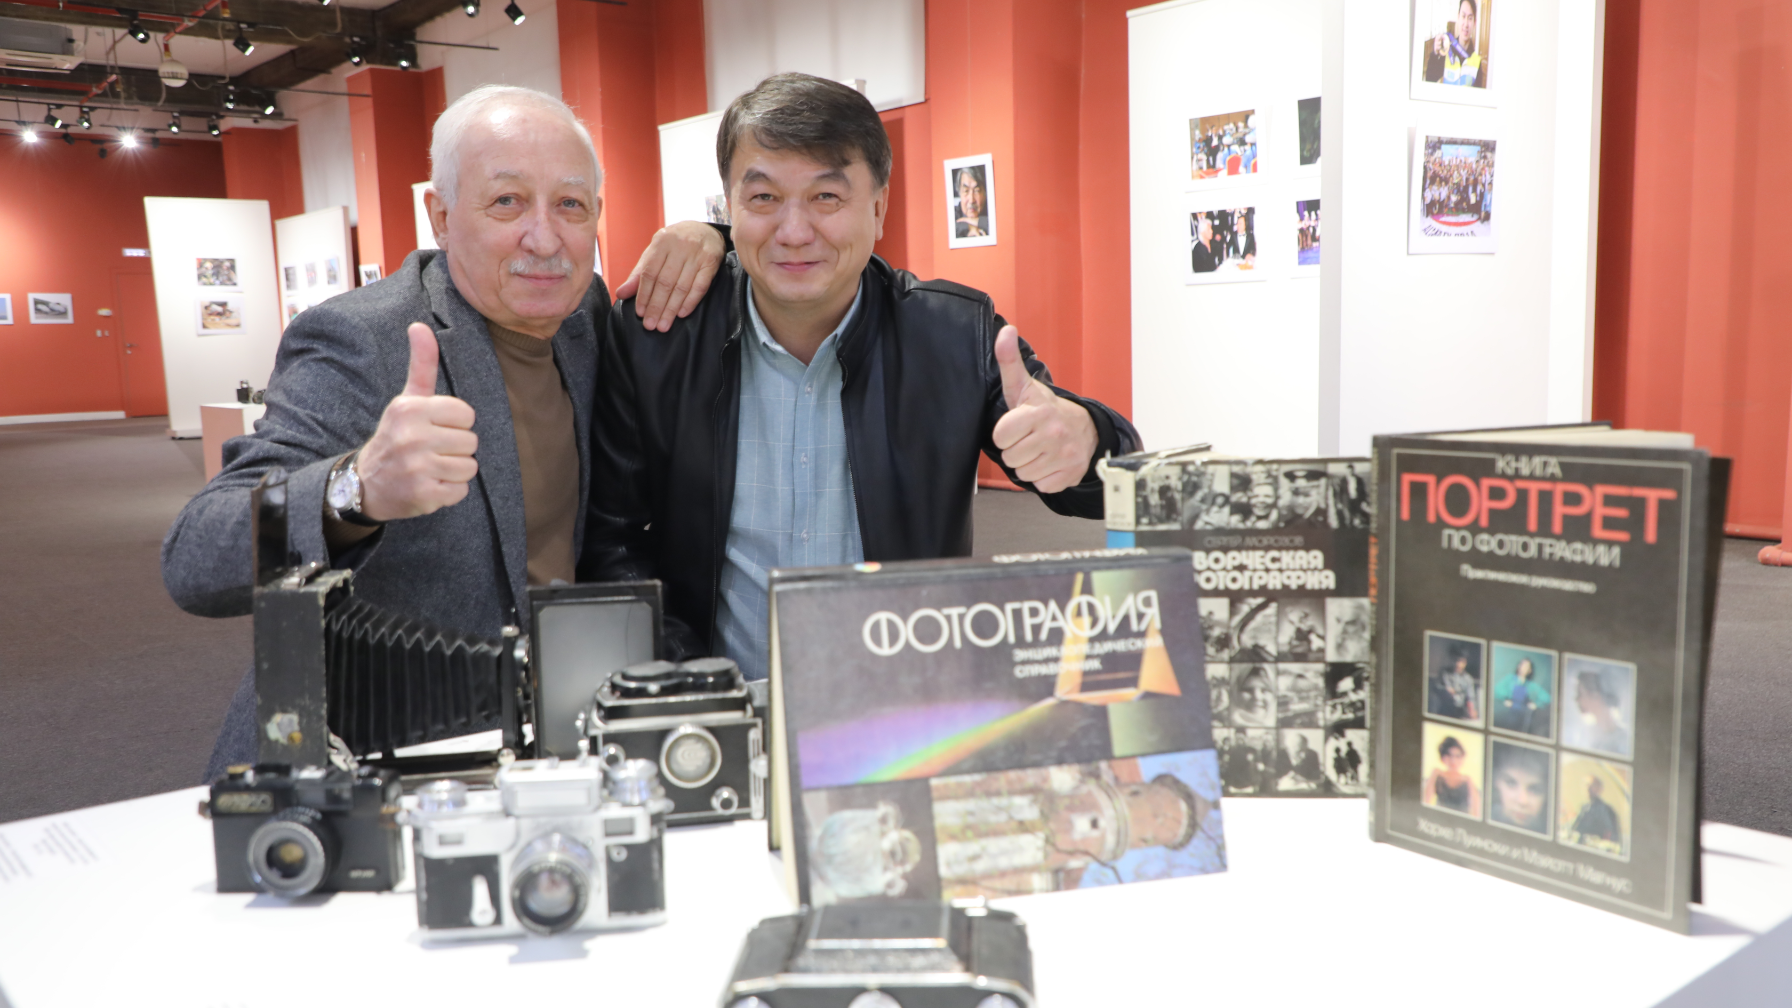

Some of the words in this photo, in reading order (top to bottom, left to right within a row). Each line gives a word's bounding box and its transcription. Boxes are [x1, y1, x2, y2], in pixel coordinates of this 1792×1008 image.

[1495, 454, 1562, 478] КНИГА
[1400, 472, 1677, 544] ПОРТРЕТ
[1192, 549, 1324, 570] ВОРЧЕСКАЯ
[1442, 529, 1472, 551] ПО
[1474, 532, 1621, 568] ФОТОГРАФИИ
[1193, 570, 1336, 590] ОТОГРАФИЯ
[862, 589, 1162, 656] ФОТОГРАФИЯ
[1013, 658, 1103, 679] СПРАВОЧНИК
